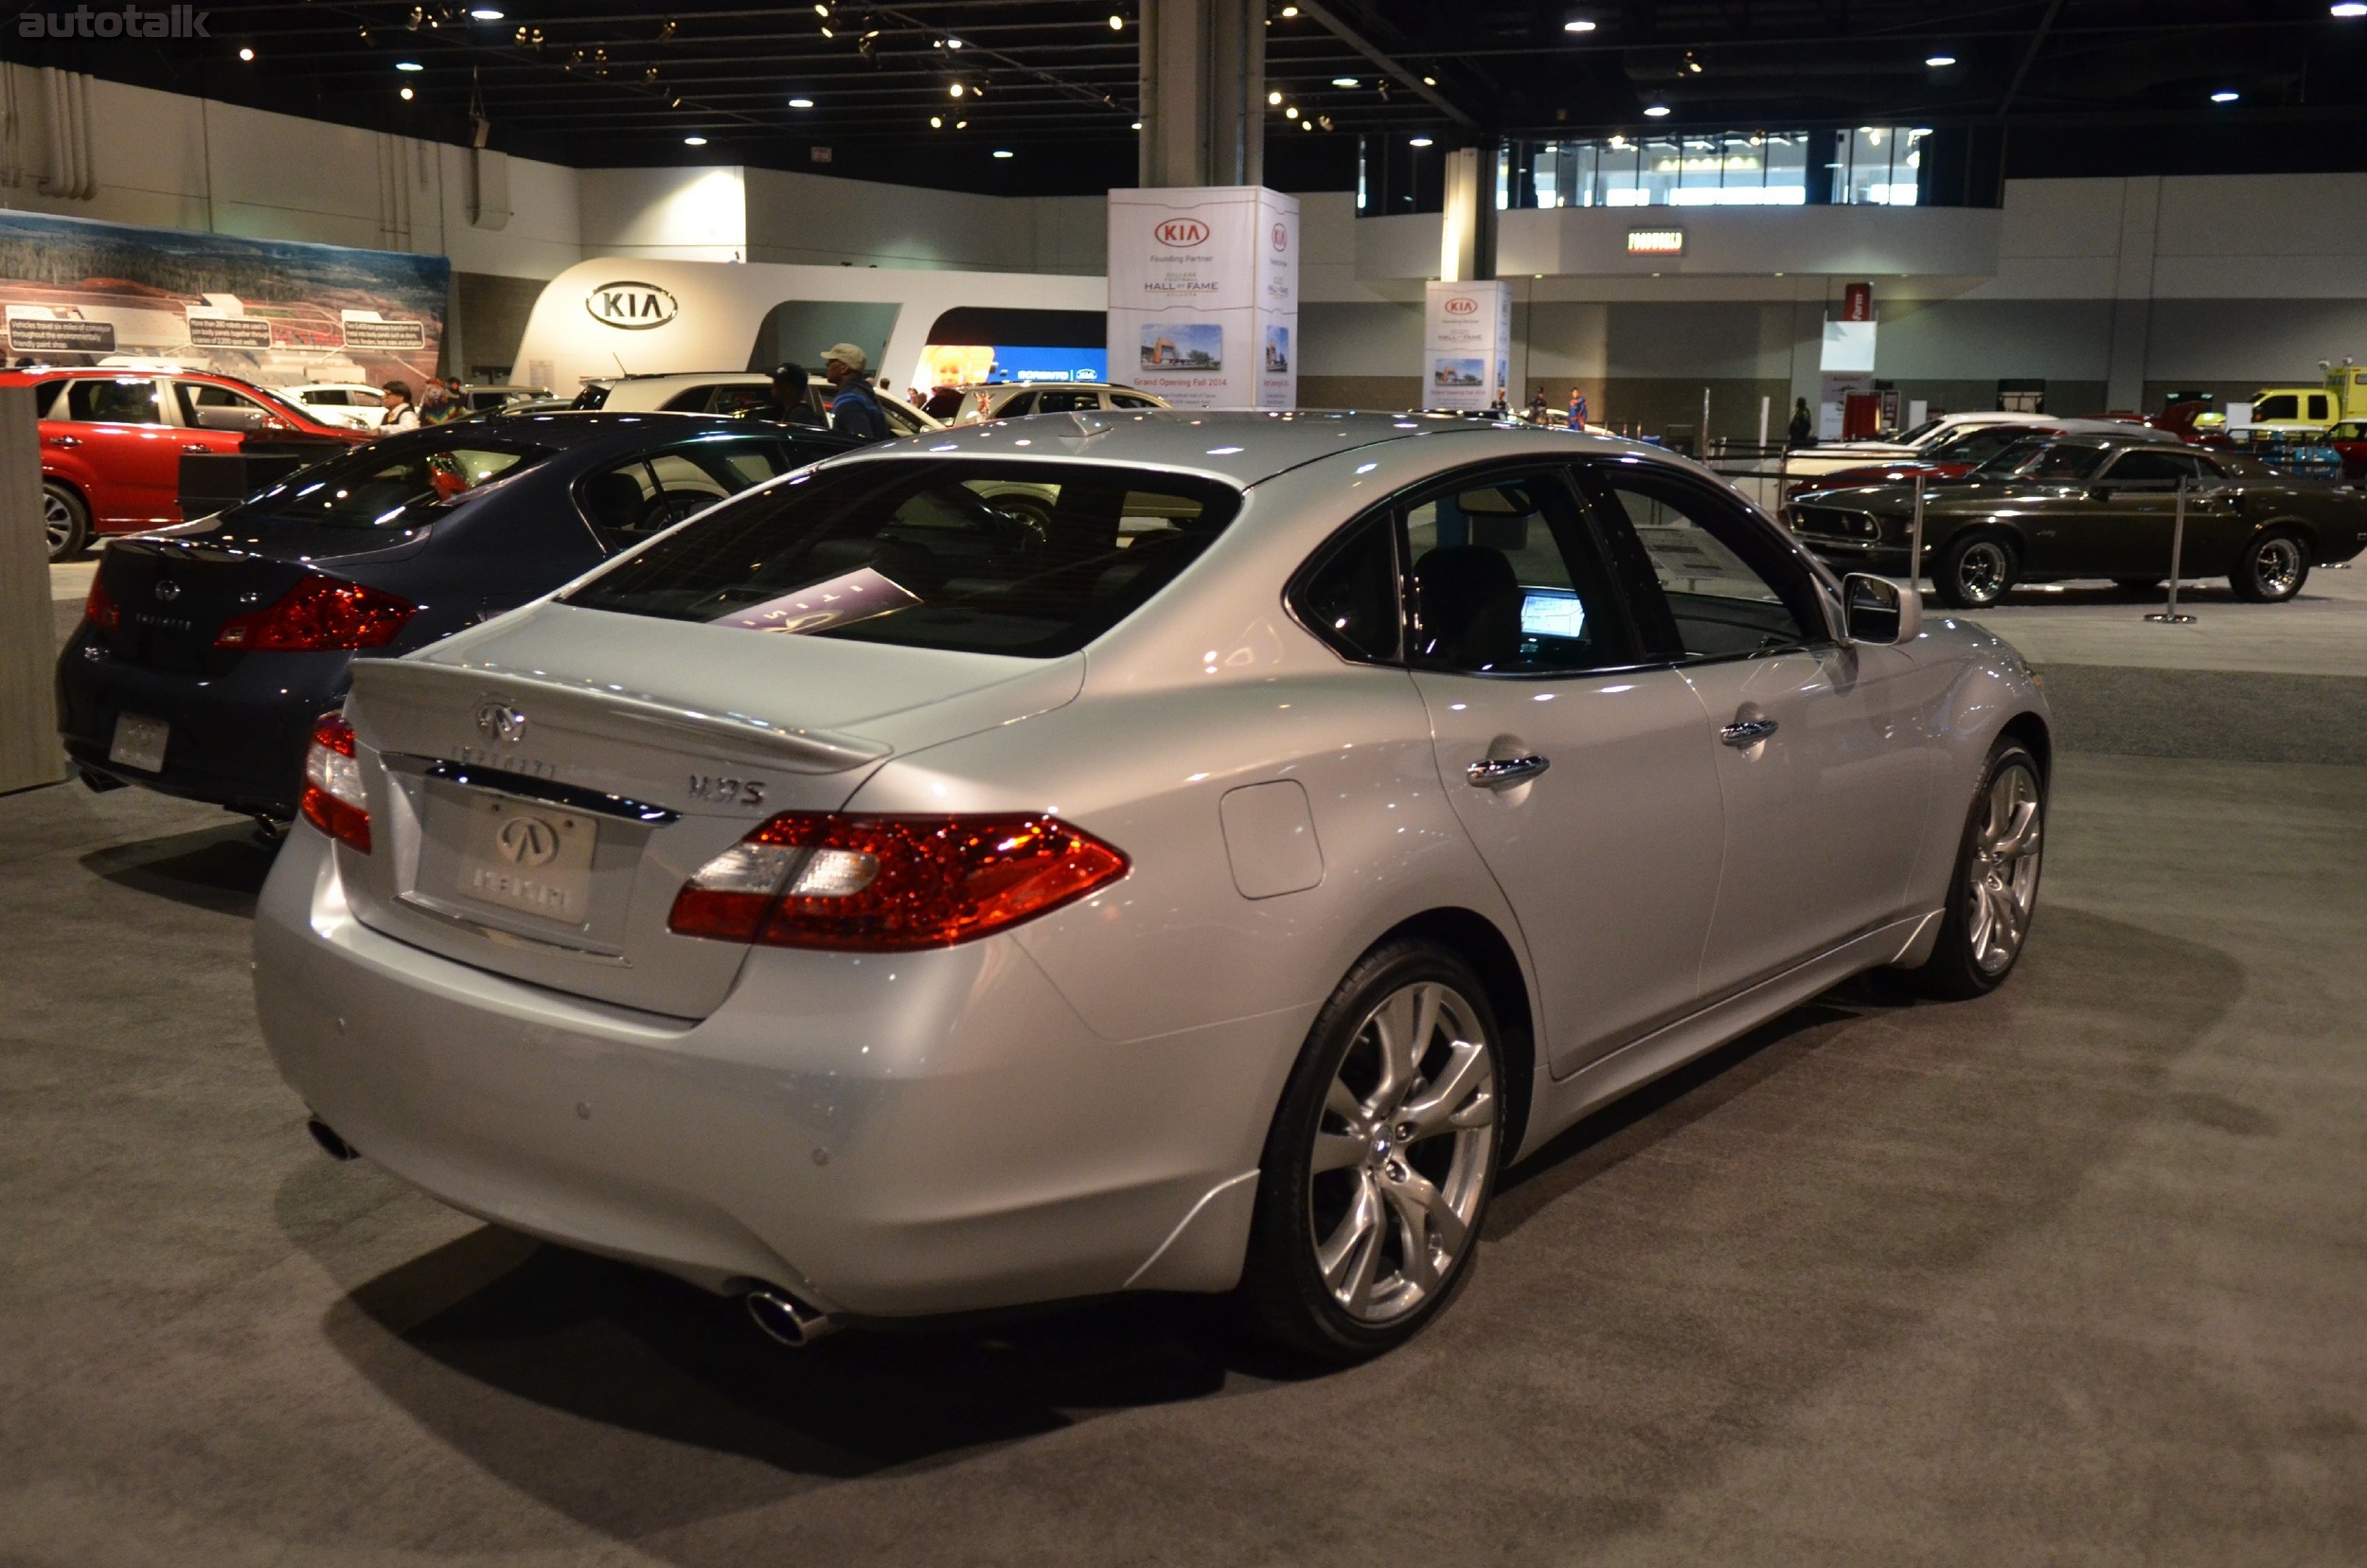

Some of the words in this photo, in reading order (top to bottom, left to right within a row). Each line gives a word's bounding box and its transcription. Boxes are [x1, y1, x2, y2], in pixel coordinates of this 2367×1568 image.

[1164, 224, 1201, 241] KIA
[1149, 255, 1184, 264] Founding
[1184, 255, 1213, 263] Partner
[1145, 282, 1176, 291] HALL
[1186, 282, 1219, 291] FAME
[602, 292, 664, 319] KIA
[1450, 302, 1473, 312] KIA
[1133, 378, 1158, 386] Grand
[1158, 378, 1192, 387] Opening
[1193, 378, 1207, 386] Fall
[1208, 378, 1228, 386] 2014
